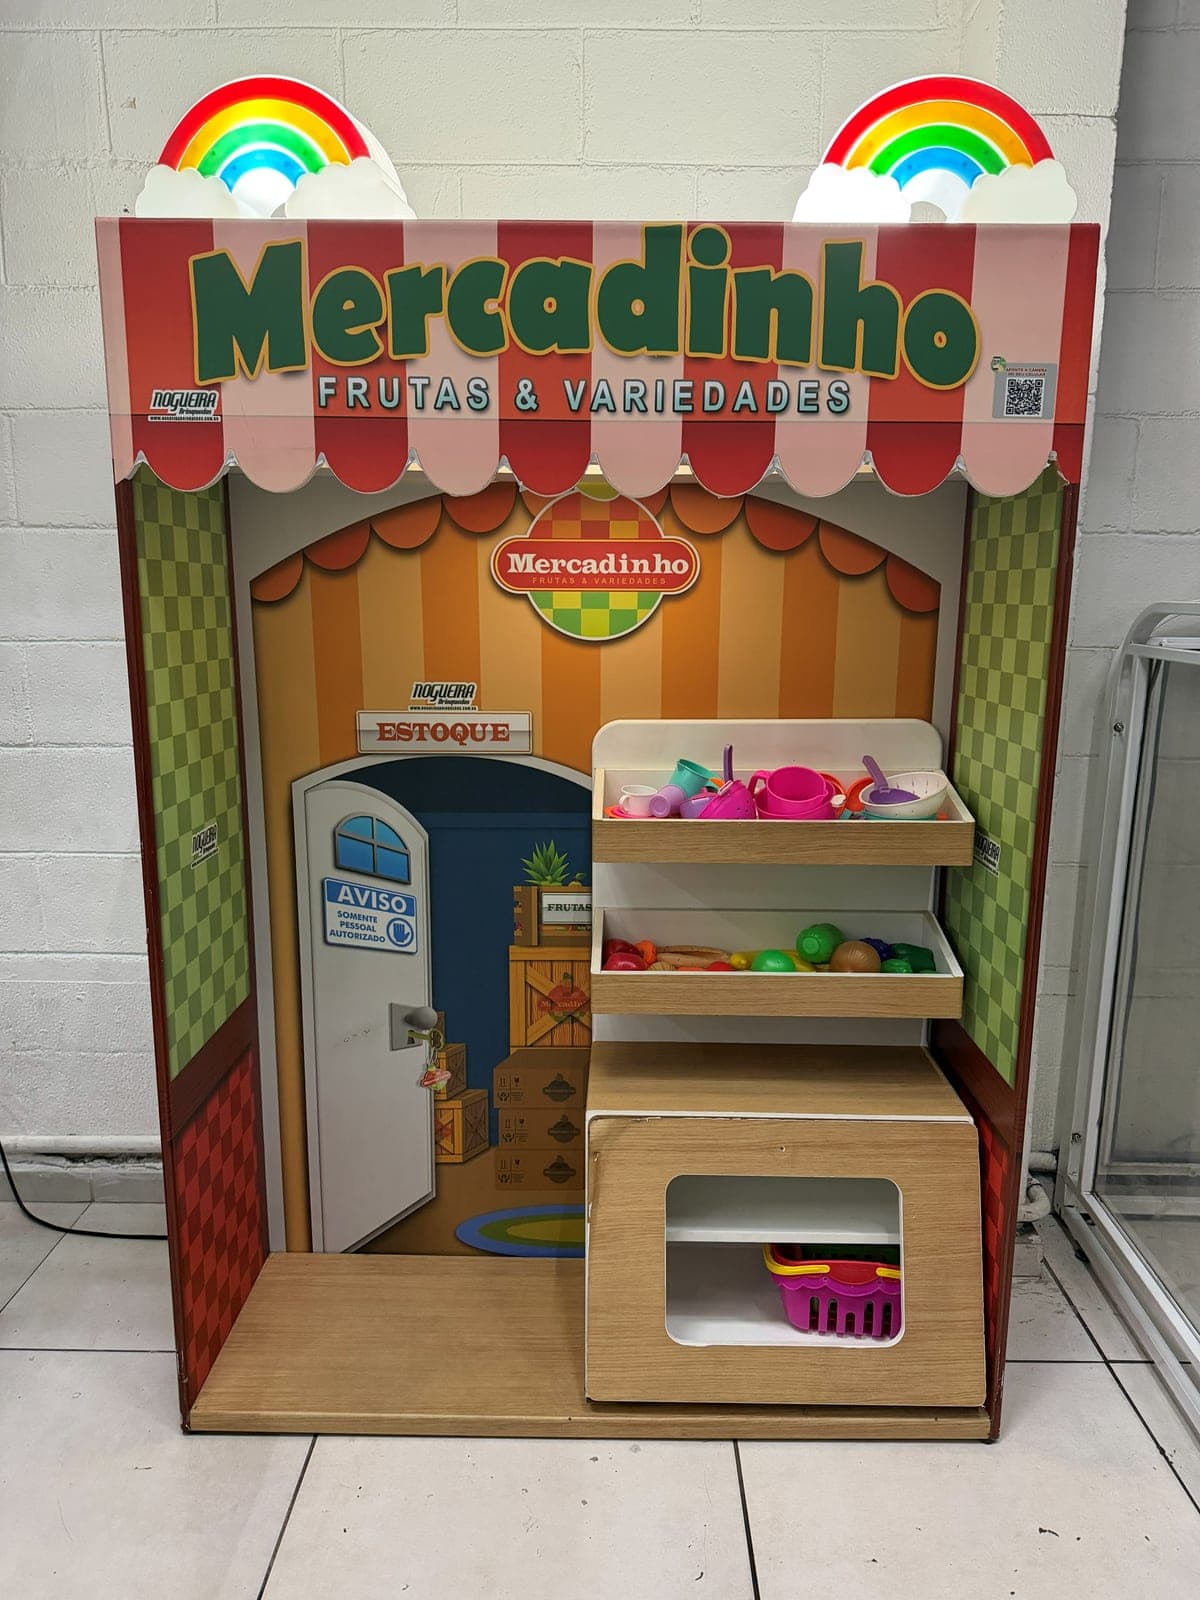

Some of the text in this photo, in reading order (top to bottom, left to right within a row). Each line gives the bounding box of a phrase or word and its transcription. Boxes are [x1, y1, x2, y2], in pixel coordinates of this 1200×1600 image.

[188, 222, 980, 390] Mercadinho
[317, 375, 851, 414] FRUTAS & VARIEDADES
[507, 553, 690, 575] Mercadinho
[532, 577, 576, 585] FRUTAS
[594, 577, 667, 585] VARIEDADES
[375, 722, 511, 746] ESTOQUE
[337, 885, 407, 914] AVISO
[546, 903, 592, 912] FRUTAS
[337, 910, 378, 923] SOMENTE
[340, 920, 377, 933] PESSOAL
[329, 929, 386, 943] AUTORIZADO
